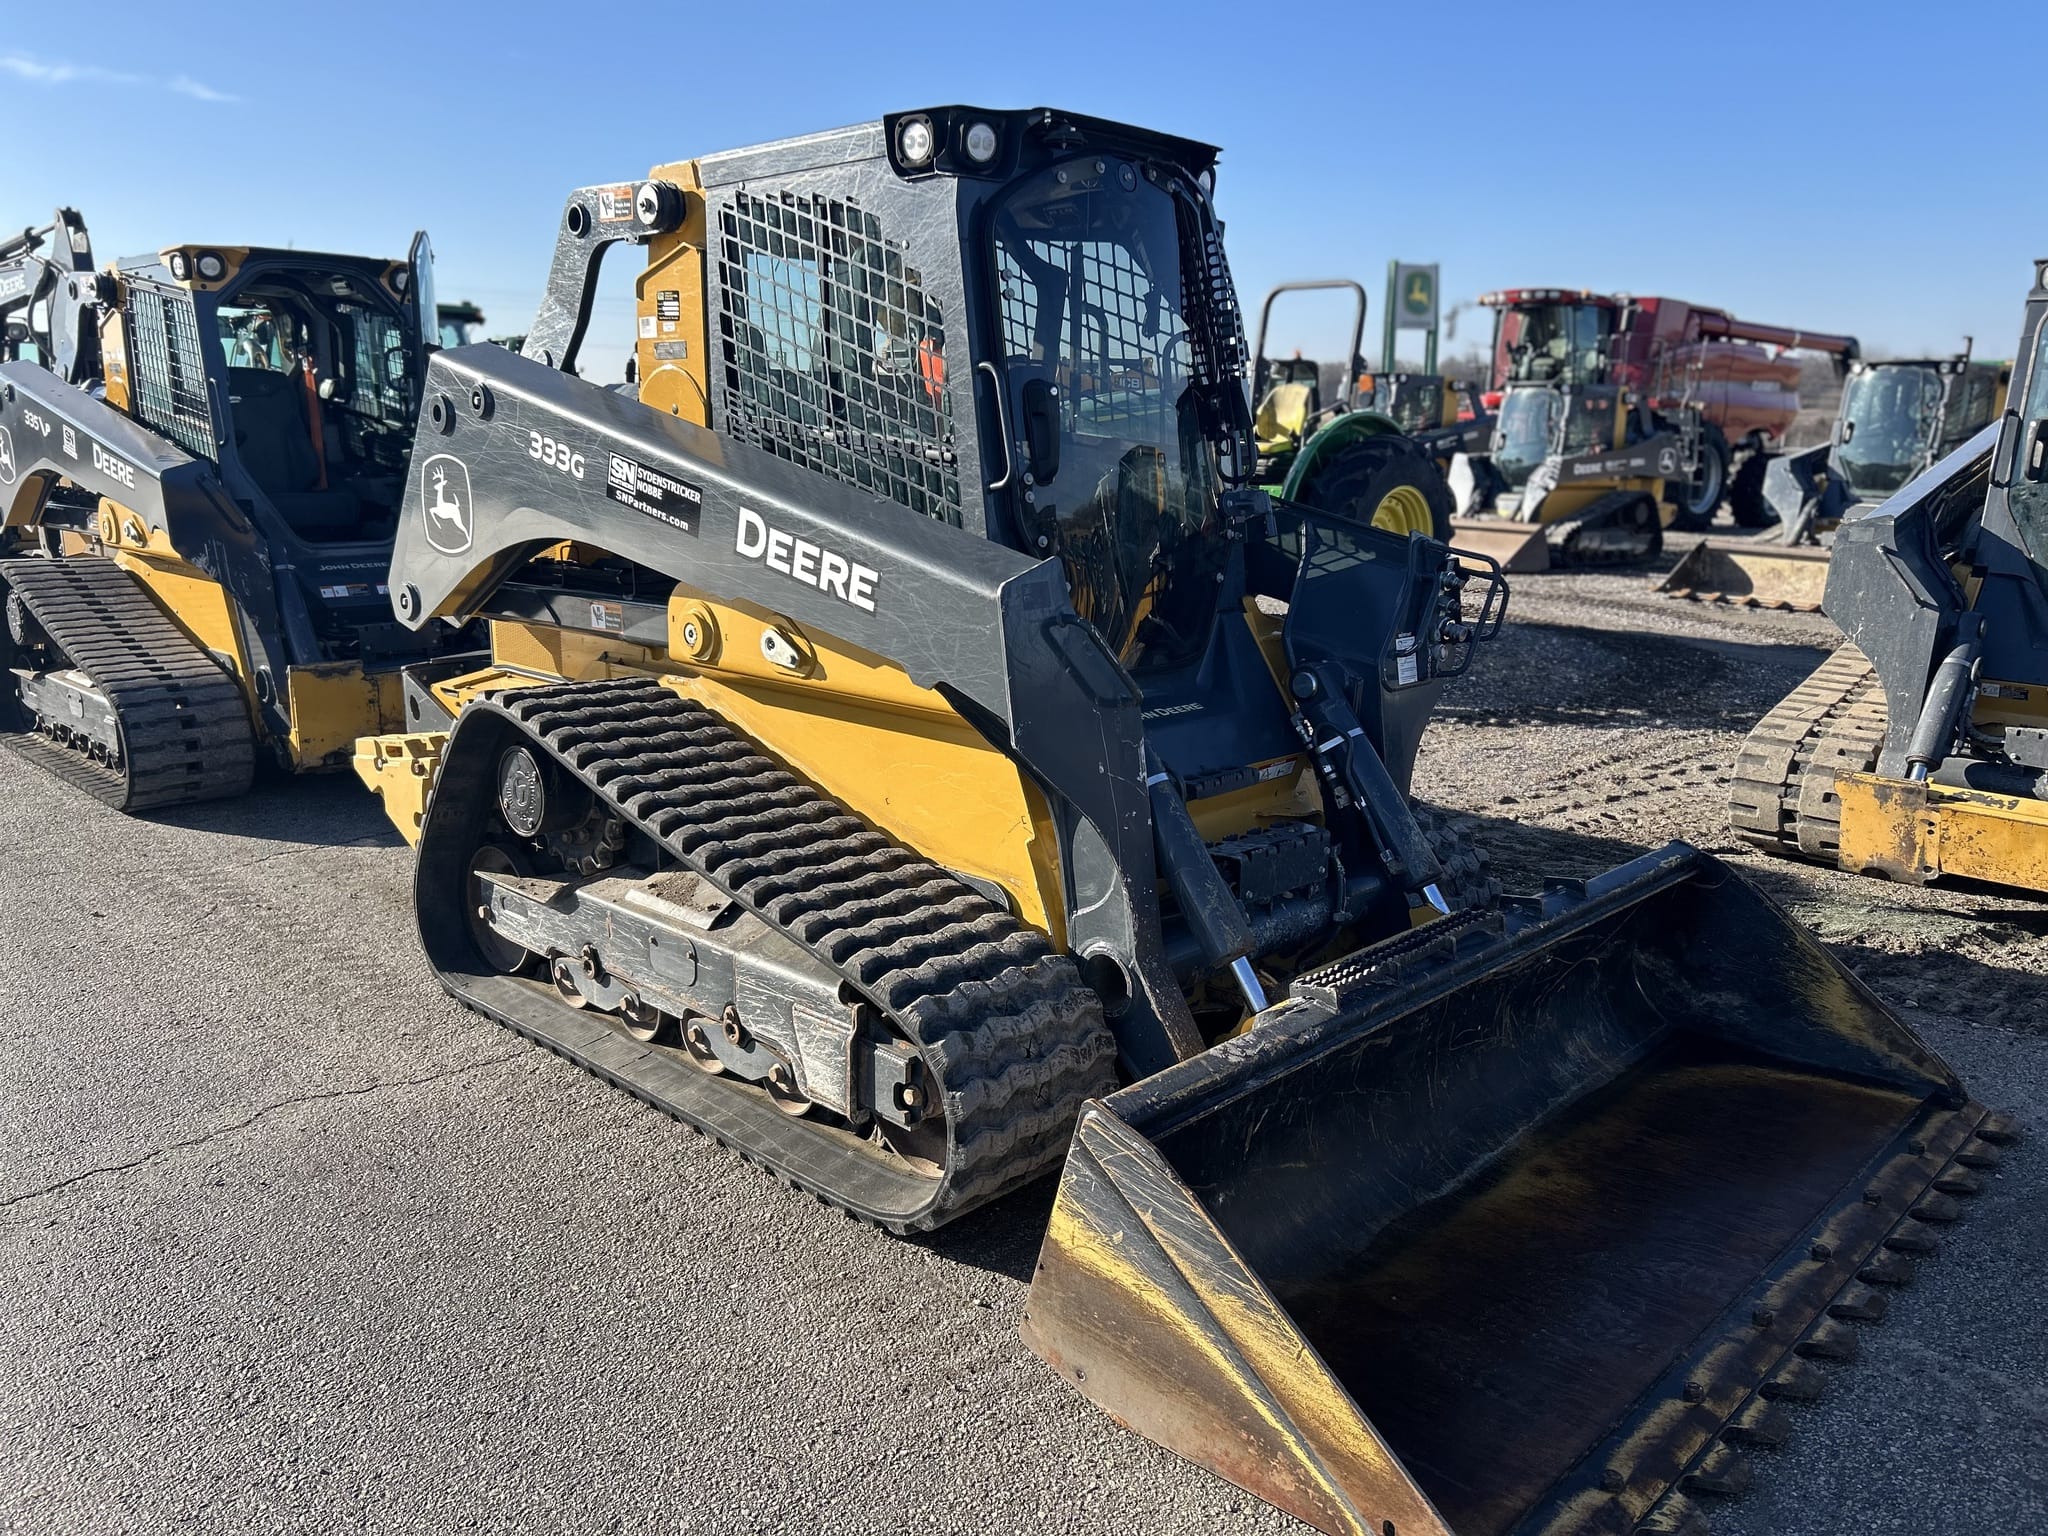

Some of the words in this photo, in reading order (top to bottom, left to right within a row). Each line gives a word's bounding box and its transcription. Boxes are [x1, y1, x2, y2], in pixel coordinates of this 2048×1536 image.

[92, 441, 135, 489] DEERE
[528, 431, 585, 479] 333G
[611, 457, 636, 485] SN
[636, 480, 663, 500] NOBBE
[637, 467, 701, 504] SYDENSTRICKER
[616, 490, 689, 531] SNPartners.com
[319, 563, 350, 571] JOHN
[350, 561, 388, 569] DEERE
[736, 506, 879, 612] DEERE
[1153, 702, 1204, 716] DEERE
